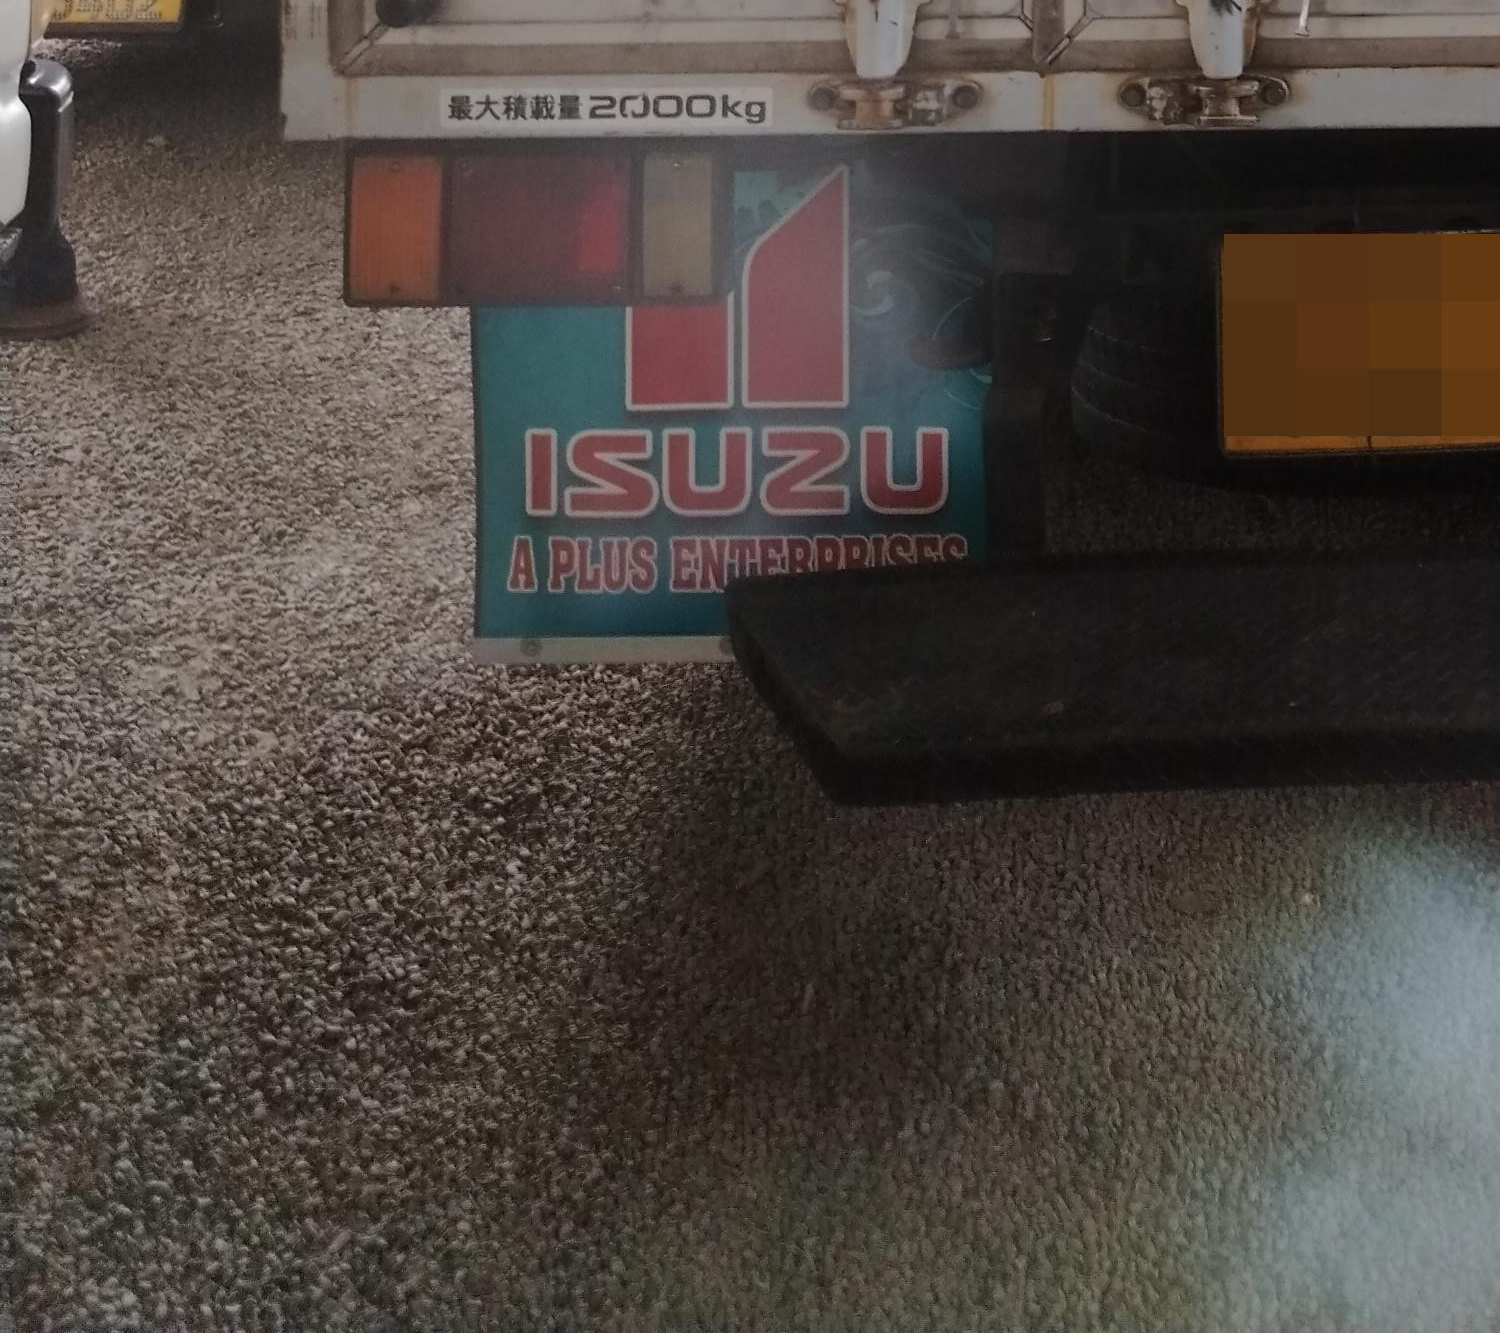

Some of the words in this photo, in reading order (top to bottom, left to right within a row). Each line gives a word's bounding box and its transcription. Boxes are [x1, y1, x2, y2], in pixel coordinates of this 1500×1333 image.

[525, 426, 950, 518] ISUZU
[507, 535, 539, 594] A
[548, 536, 658, 595] PLUS
